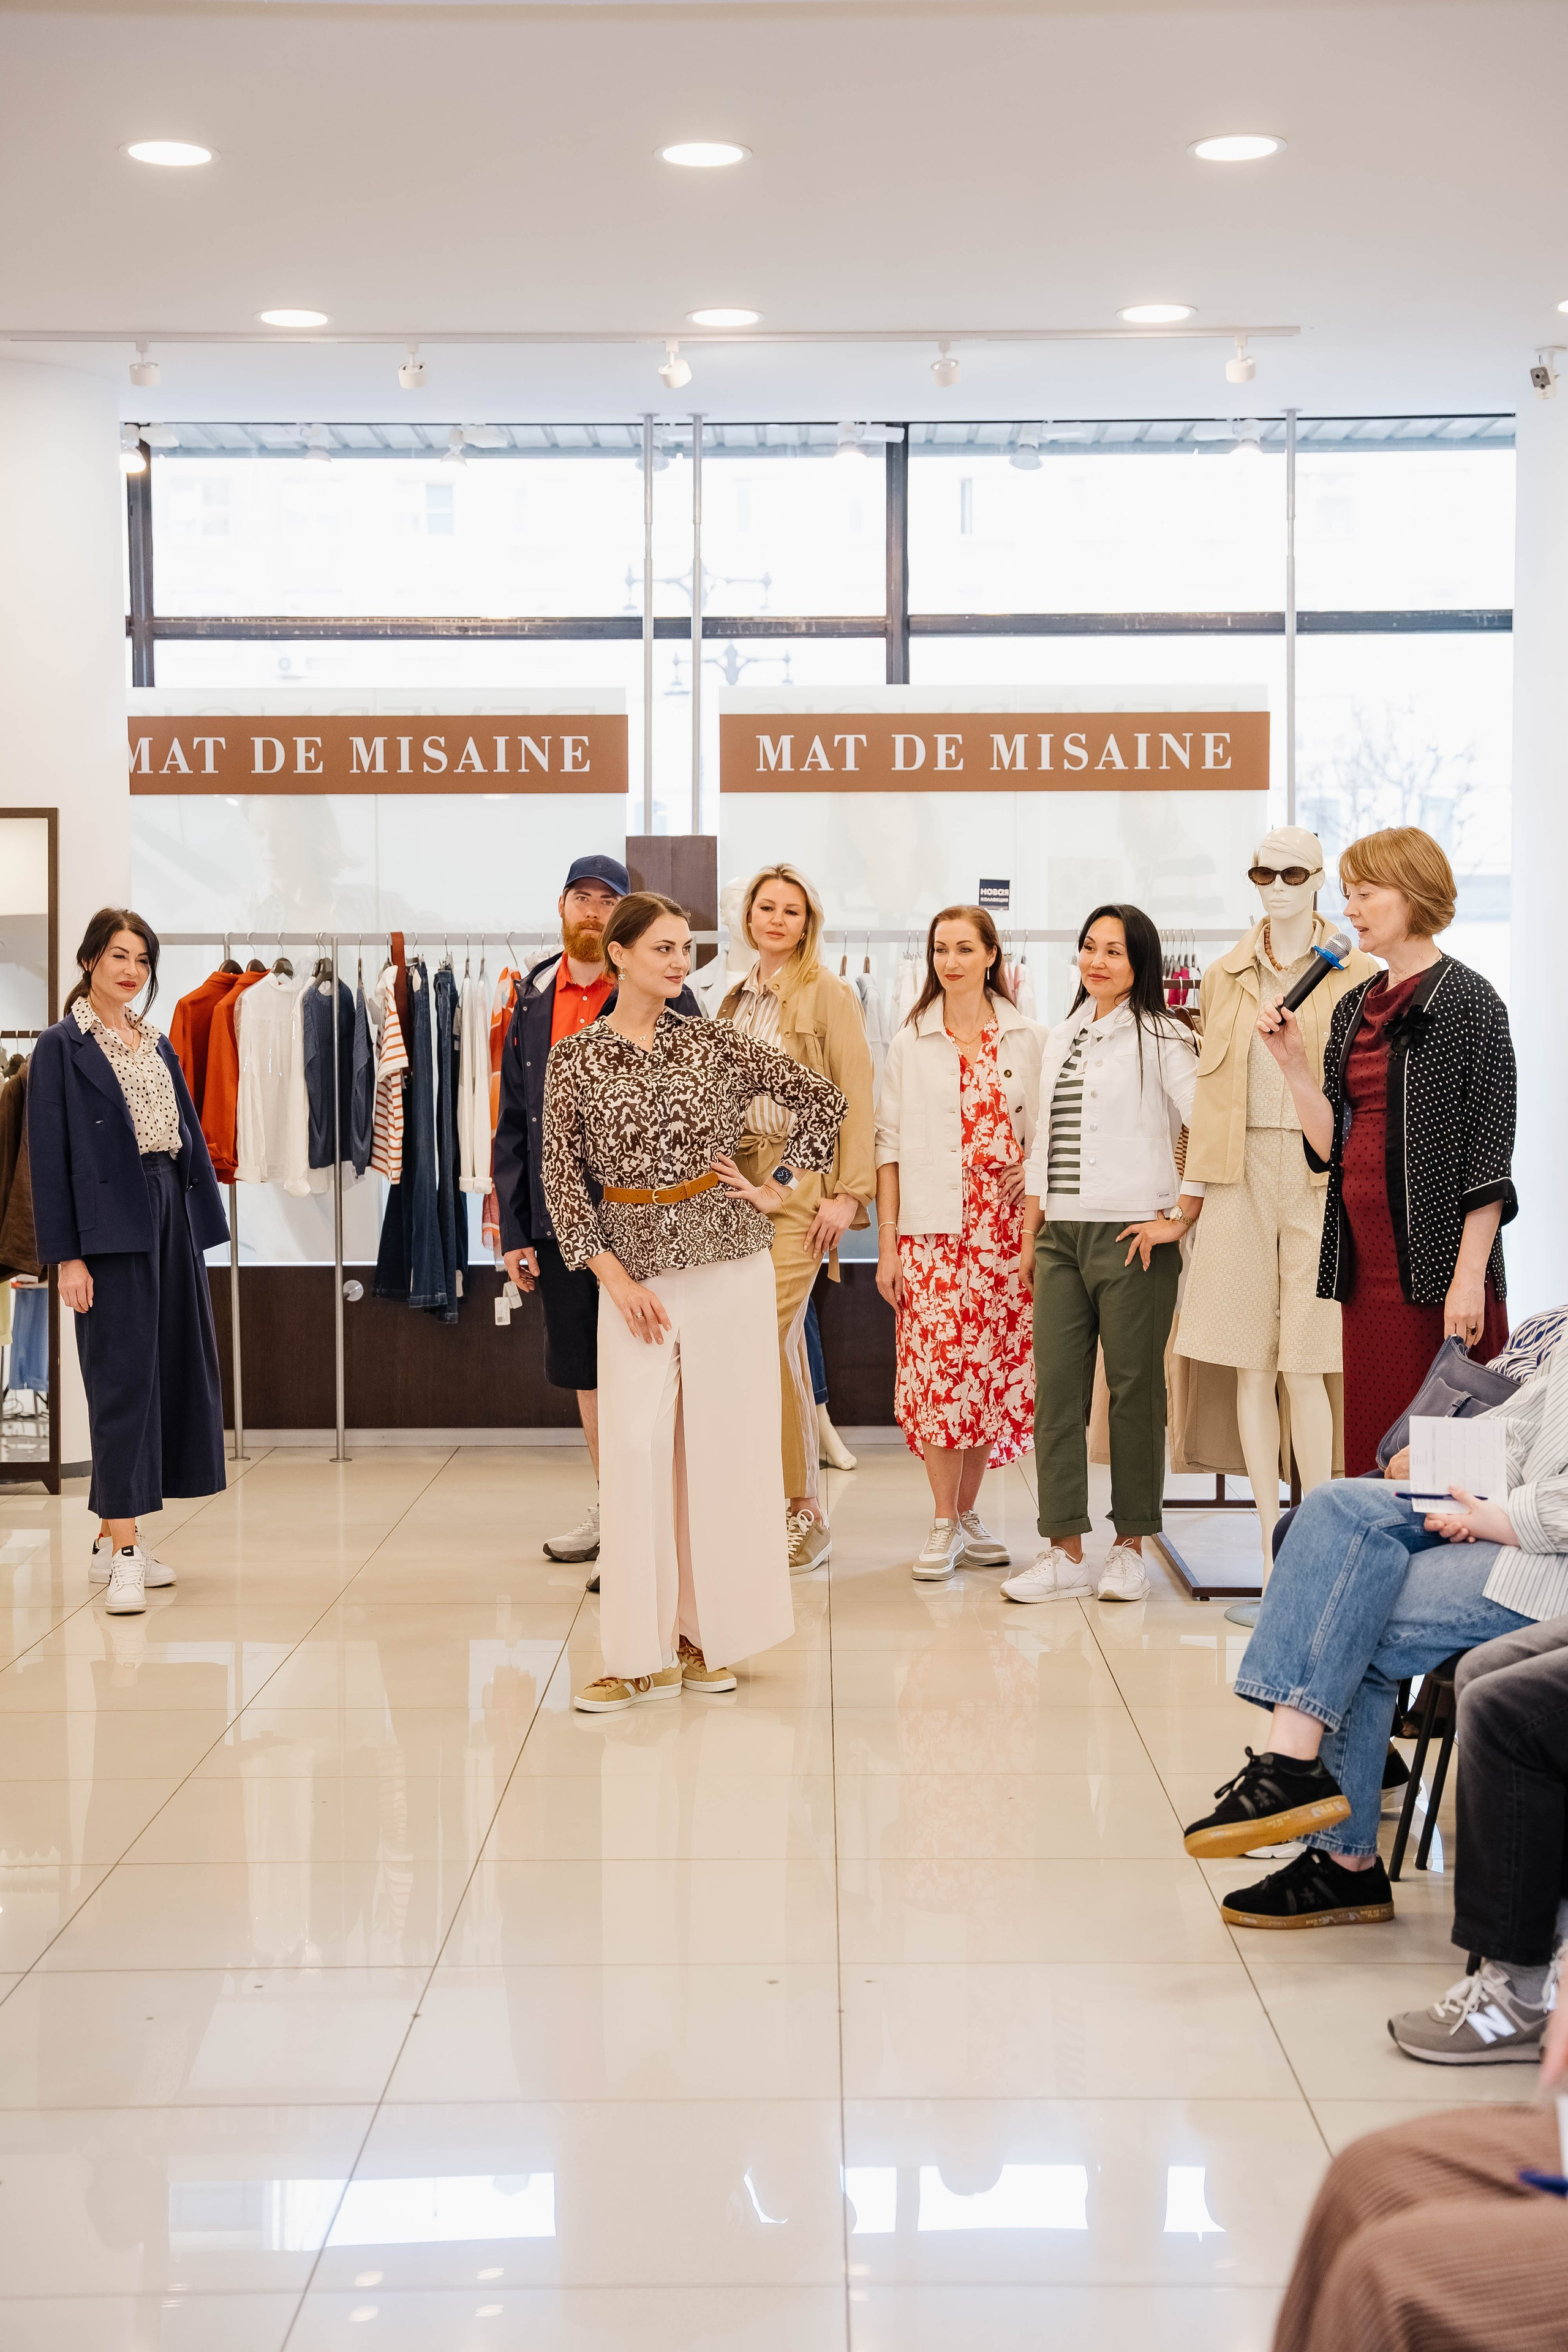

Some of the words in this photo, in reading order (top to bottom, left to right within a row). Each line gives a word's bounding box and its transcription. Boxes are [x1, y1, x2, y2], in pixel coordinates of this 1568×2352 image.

[128, 737, 226, 774] MAT
[250, 737, 323, 774] DE
[349, 736, 590, 774] MISAINE
[755, 734, 867, 772] MAT
[891, 734, 964, 771] DE
[989, 732, 1232, 771] MISAINE
